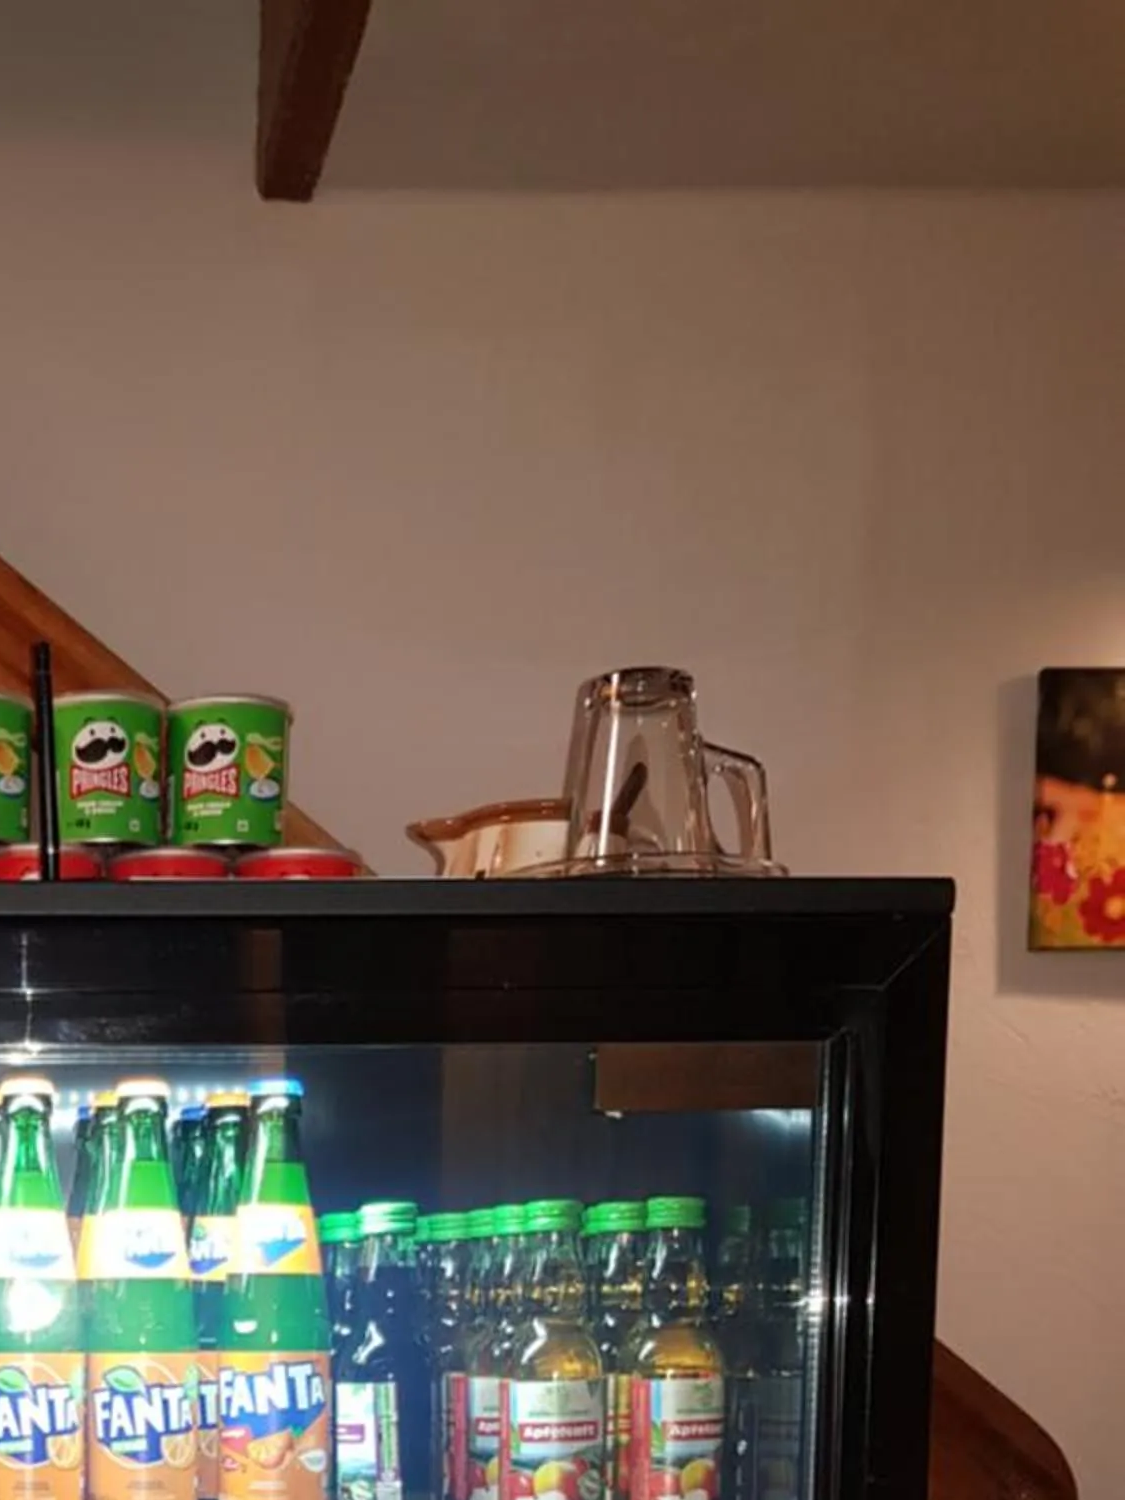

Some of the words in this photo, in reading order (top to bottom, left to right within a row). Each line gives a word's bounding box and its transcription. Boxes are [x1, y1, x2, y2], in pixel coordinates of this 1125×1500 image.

[73, 766, 129, 797] PRINGLES
[184, 766, 238, 798] PRINGLES
[218, 1362, 325, 1417] FANTA
[93, 1385, 193, 1440] FANTA
